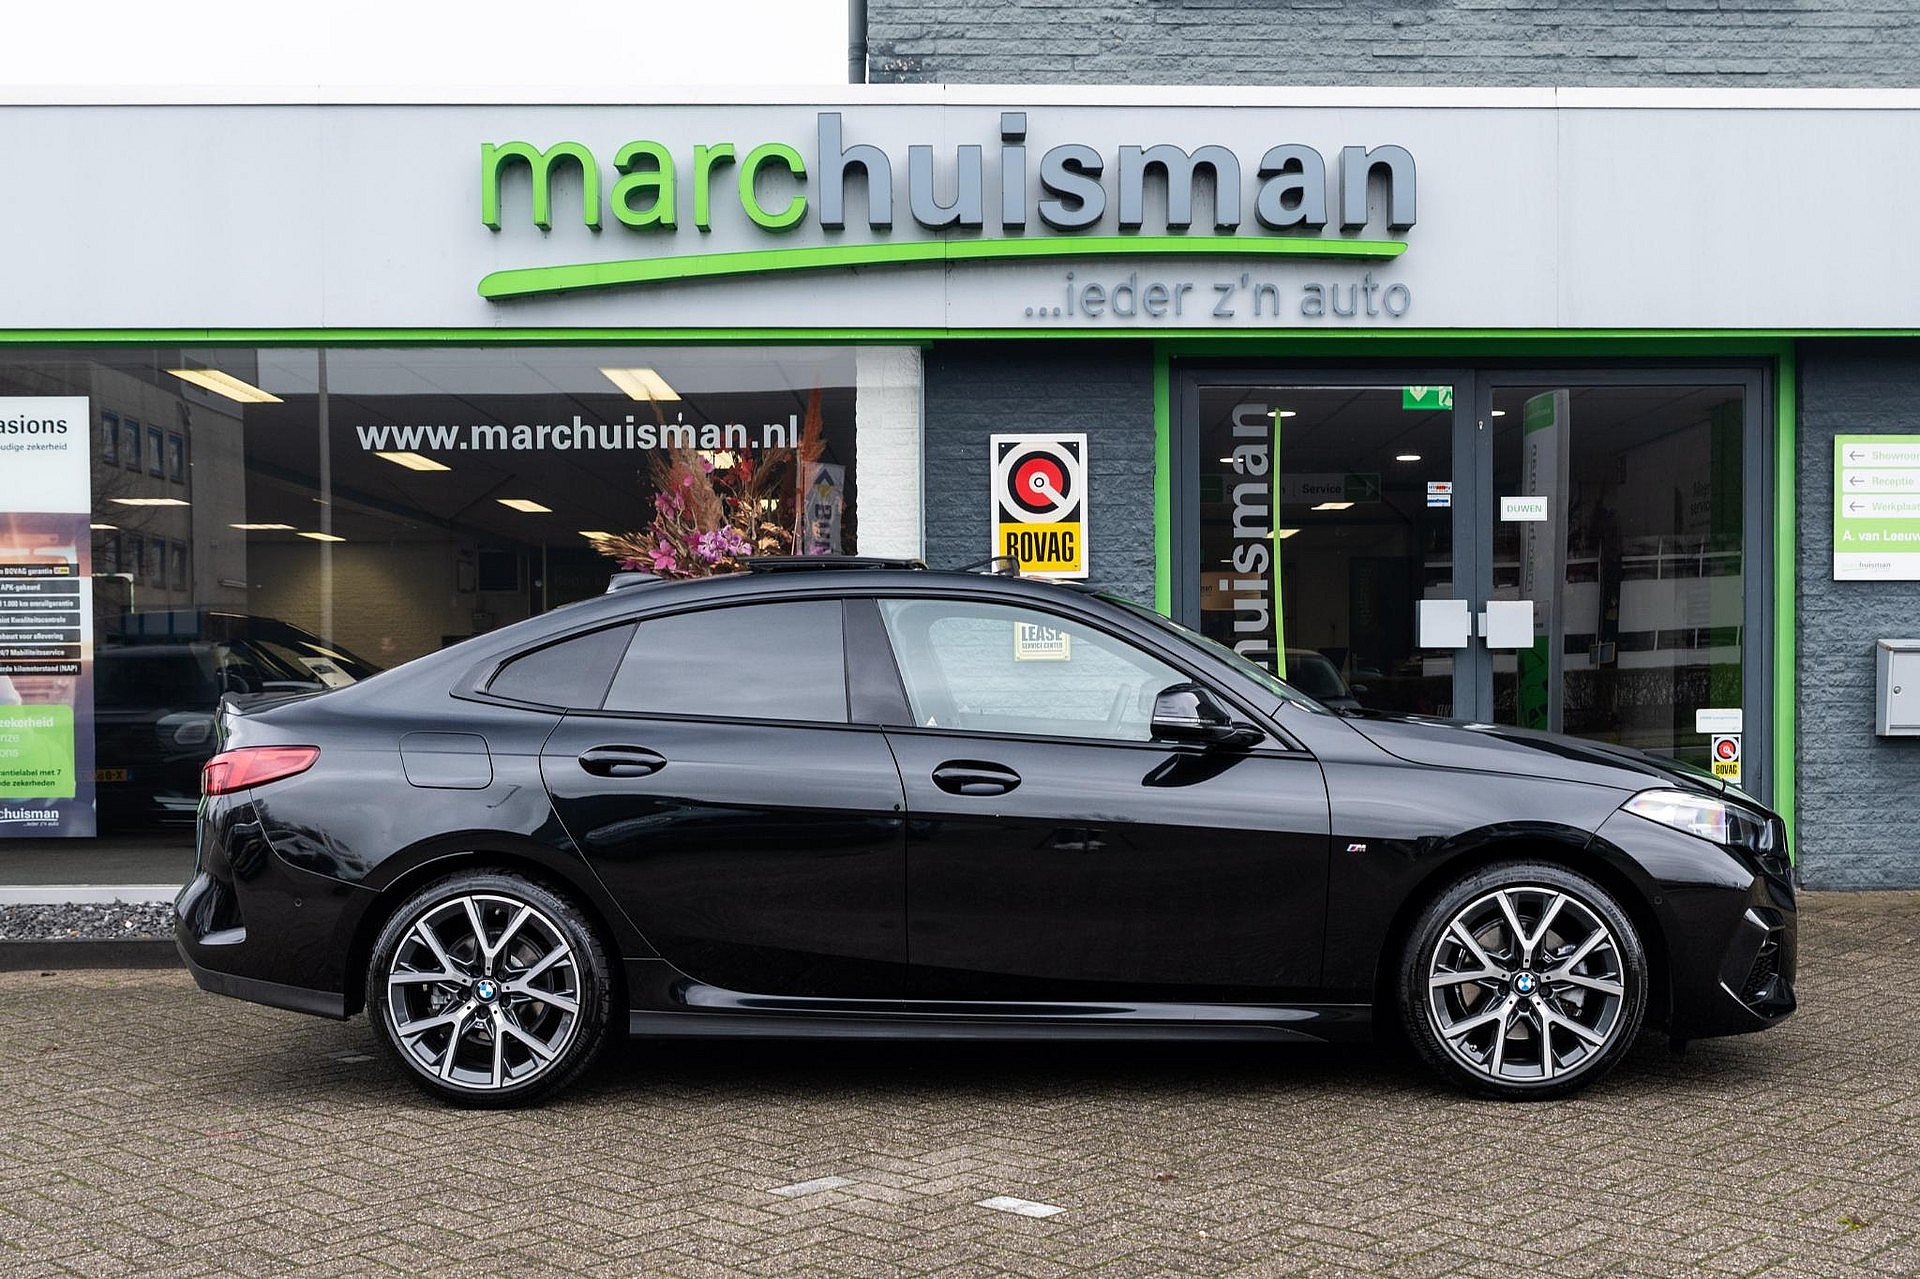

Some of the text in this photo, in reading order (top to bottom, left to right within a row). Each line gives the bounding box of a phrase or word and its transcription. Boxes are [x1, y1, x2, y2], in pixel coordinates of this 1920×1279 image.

[481, 111, 1417, 233] marchuisman
[1025, 271, 1411, 317] ...ieder z'n auto
[356, 414, 799, 451] www.marchuisman.nl
[27, 442, 67, 451] zekerheid
[1872, 476, 1914, 487] Receptie
[1302, 483, 1342, 495] Service
[1507, 504, 1542, 513] DUWEN
[1859, 532, 1880, 541] van
[1007, 531, 1074, 563] BOVAG
[1716, 764, 1737, 775] BOVAG
[13, 779, 55, 787] zekerheden
